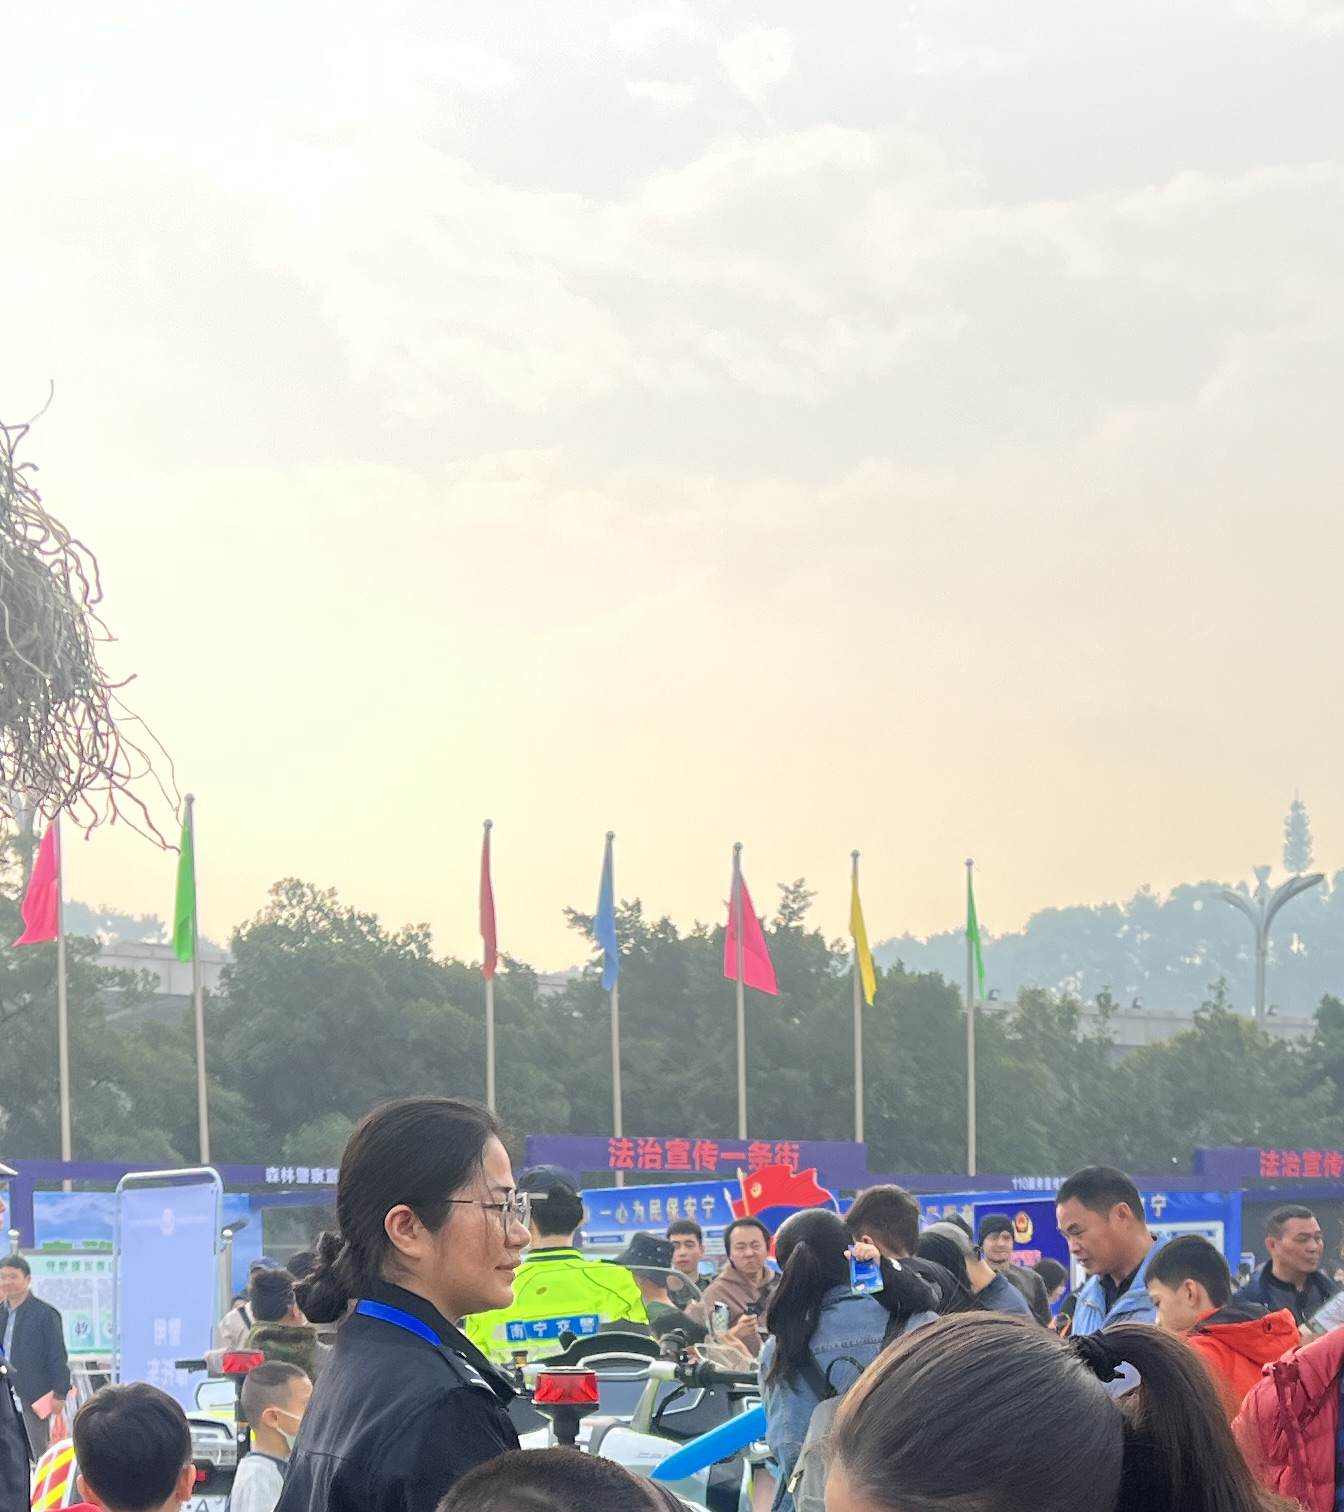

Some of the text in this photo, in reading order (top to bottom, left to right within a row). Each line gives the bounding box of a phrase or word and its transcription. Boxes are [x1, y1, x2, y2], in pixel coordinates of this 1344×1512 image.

[609, 1137, 800, 1171] 法治宣传一条街
